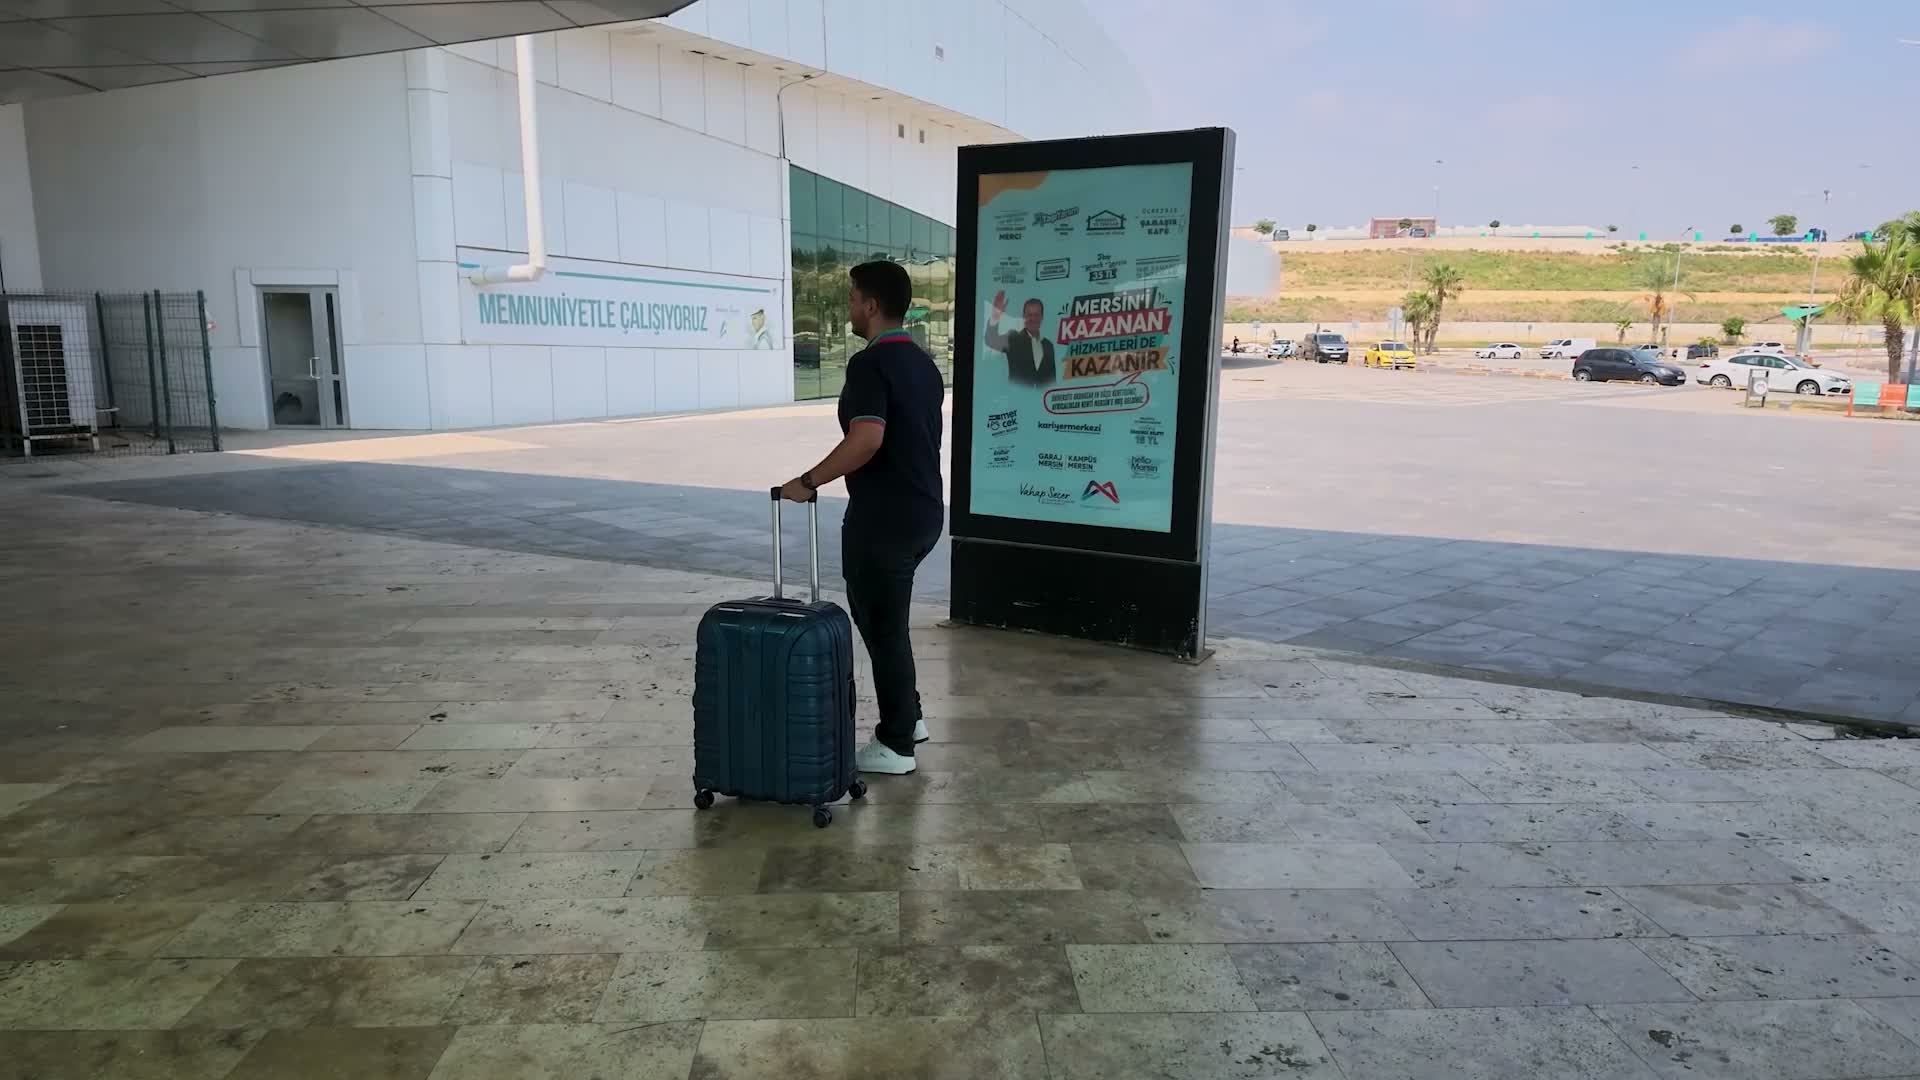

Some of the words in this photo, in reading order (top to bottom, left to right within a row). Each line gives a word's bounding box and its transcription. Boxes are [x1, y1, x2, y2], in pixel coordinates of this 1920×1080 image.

[478, 292, 616, 328] MEMNUNİYETLE
[620, 301, 708, 334] ÇALIŞIYORUZ
[1074, 289, 1152, 316] MERSİN'İ
[1060, 310, 1164, 340] KAZANAN
[1070, 337, 1138, 356] HİZMETLERİ
[1141, 336, 1156, 349] DE
[1071, 350, 1161, 377] KAZANIR
[1038, 453, 1063, 461] GARAJ
